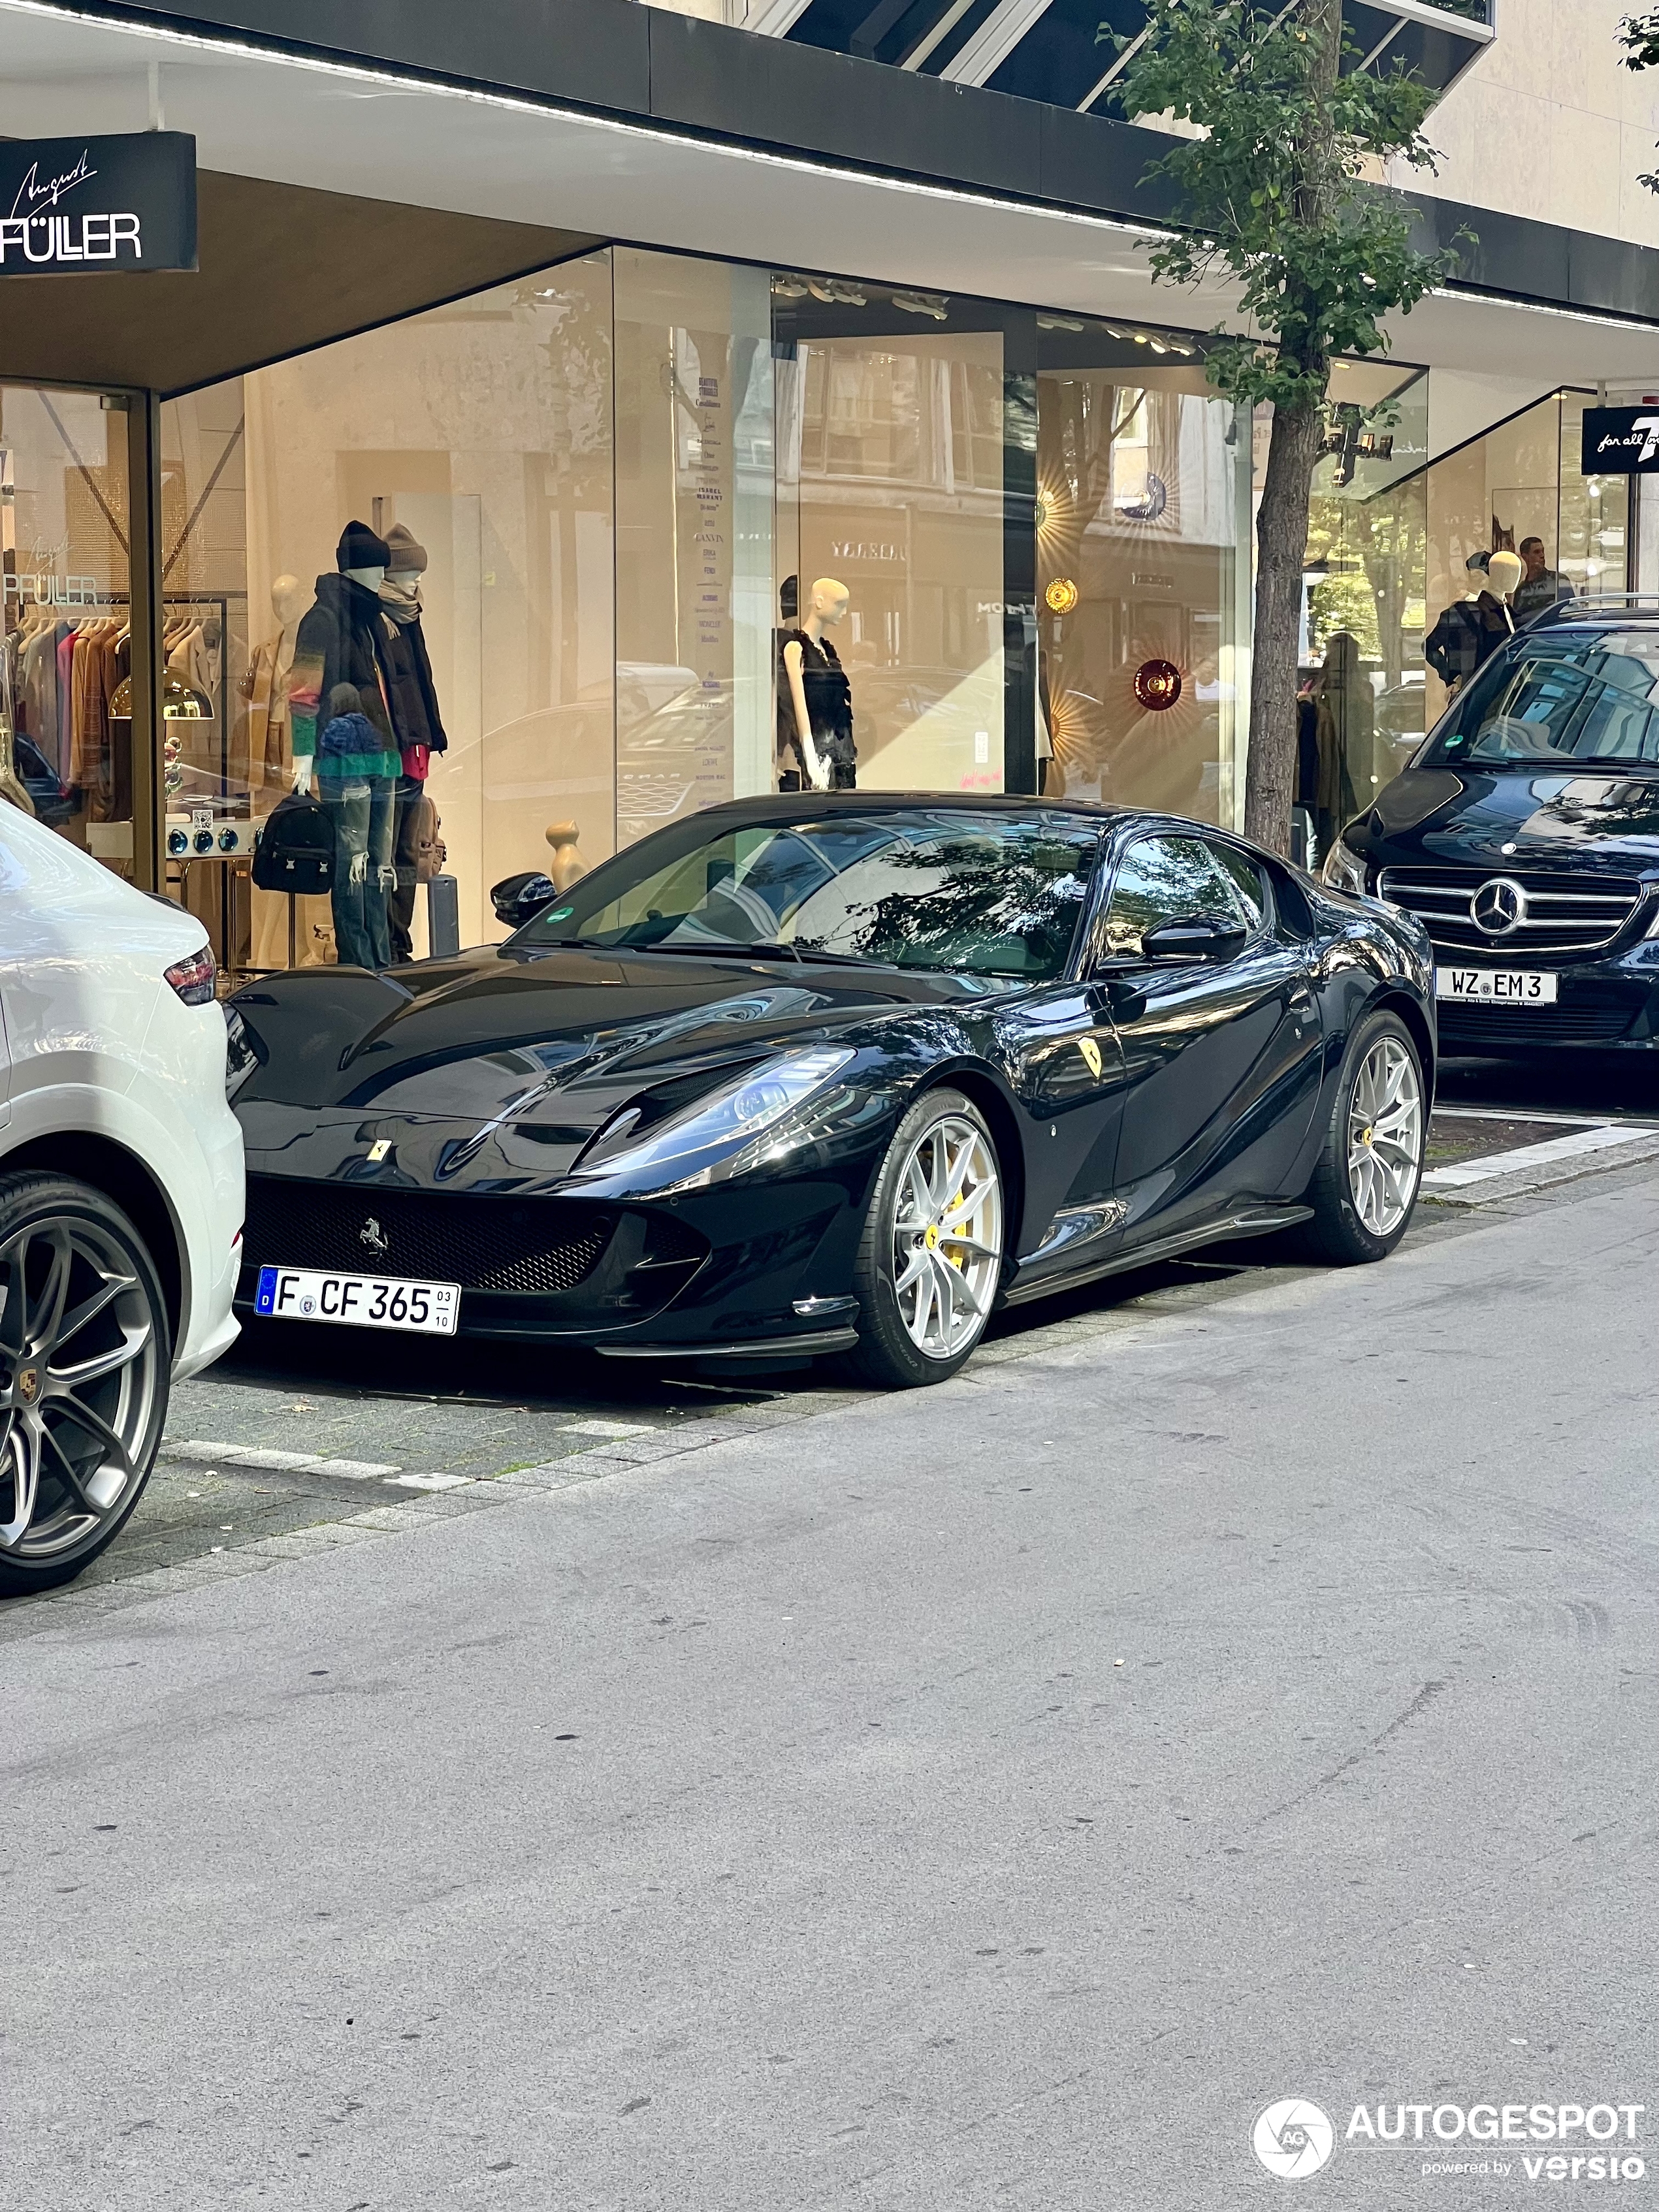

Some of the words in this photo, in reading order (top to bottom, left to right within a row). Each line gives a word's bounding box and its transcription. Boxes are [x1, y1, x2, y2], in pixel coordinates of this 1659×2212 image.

[10, 148, 97, 220] August
[1598, 434, 1621, 452] for
[1622, 434, 1643, 445] all
[1451, 971, 1479, 995] WZ
[1494, 974, 1522, 997] EM
[1528, 976, 1541, 997] 3
[262, 1295, 270, 1306] D
[278, 1275, 300, 1310] F
[321, 1279, 362, 1316] CF
[368, 1285, 431, 1323] 365
[437, 1291, 451, 1302] 03
[436, 1316, 448, 1327] 10
